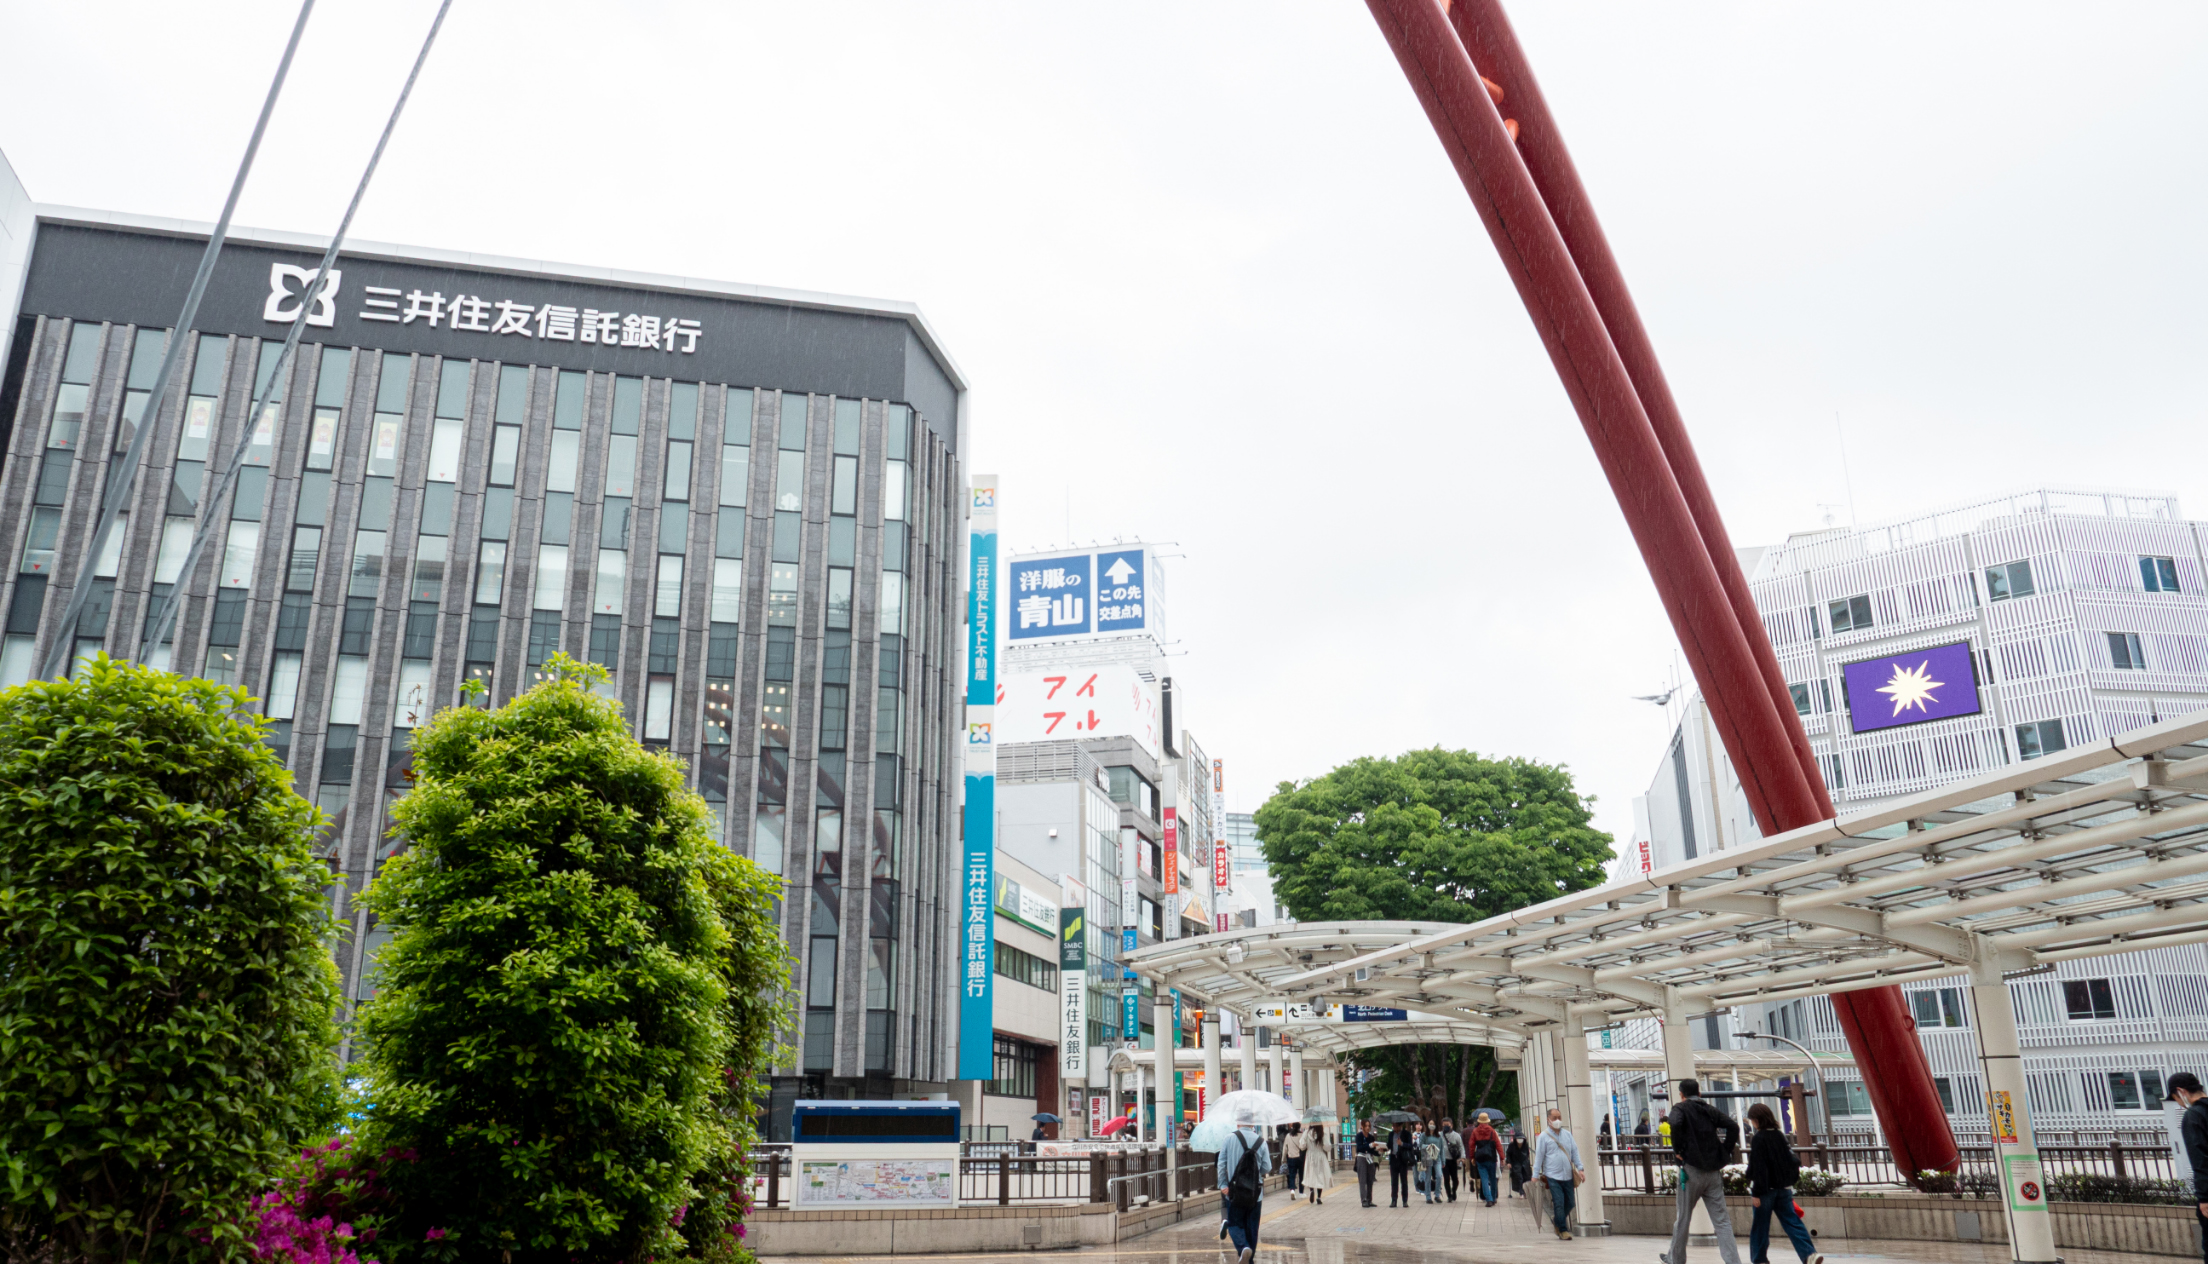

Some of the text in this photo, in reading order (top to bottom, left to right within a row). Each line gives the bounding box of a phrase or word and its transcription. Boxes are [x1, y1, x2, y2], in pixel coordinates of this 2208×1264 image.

[359, 285, 702, 354] 三井住友信託銀行
[1019, 567, 1082, 592] 洋服の
[1099, 585, 1142, 602] この先
[974, 556, 989, 681] 三井住友トラスト不動産
[1017, 593, 1084, 629] 青山
[1098, 603, 1143, 622] 交差点角
[1217, 851, 1226, 884] カラオケ
[967, 852, 987, 998] 三井住友信託銀行
[1022, 894, 1055, 927] 三井住友銀行
[1066, 977, 1081, 1070] 三井住友銀行
